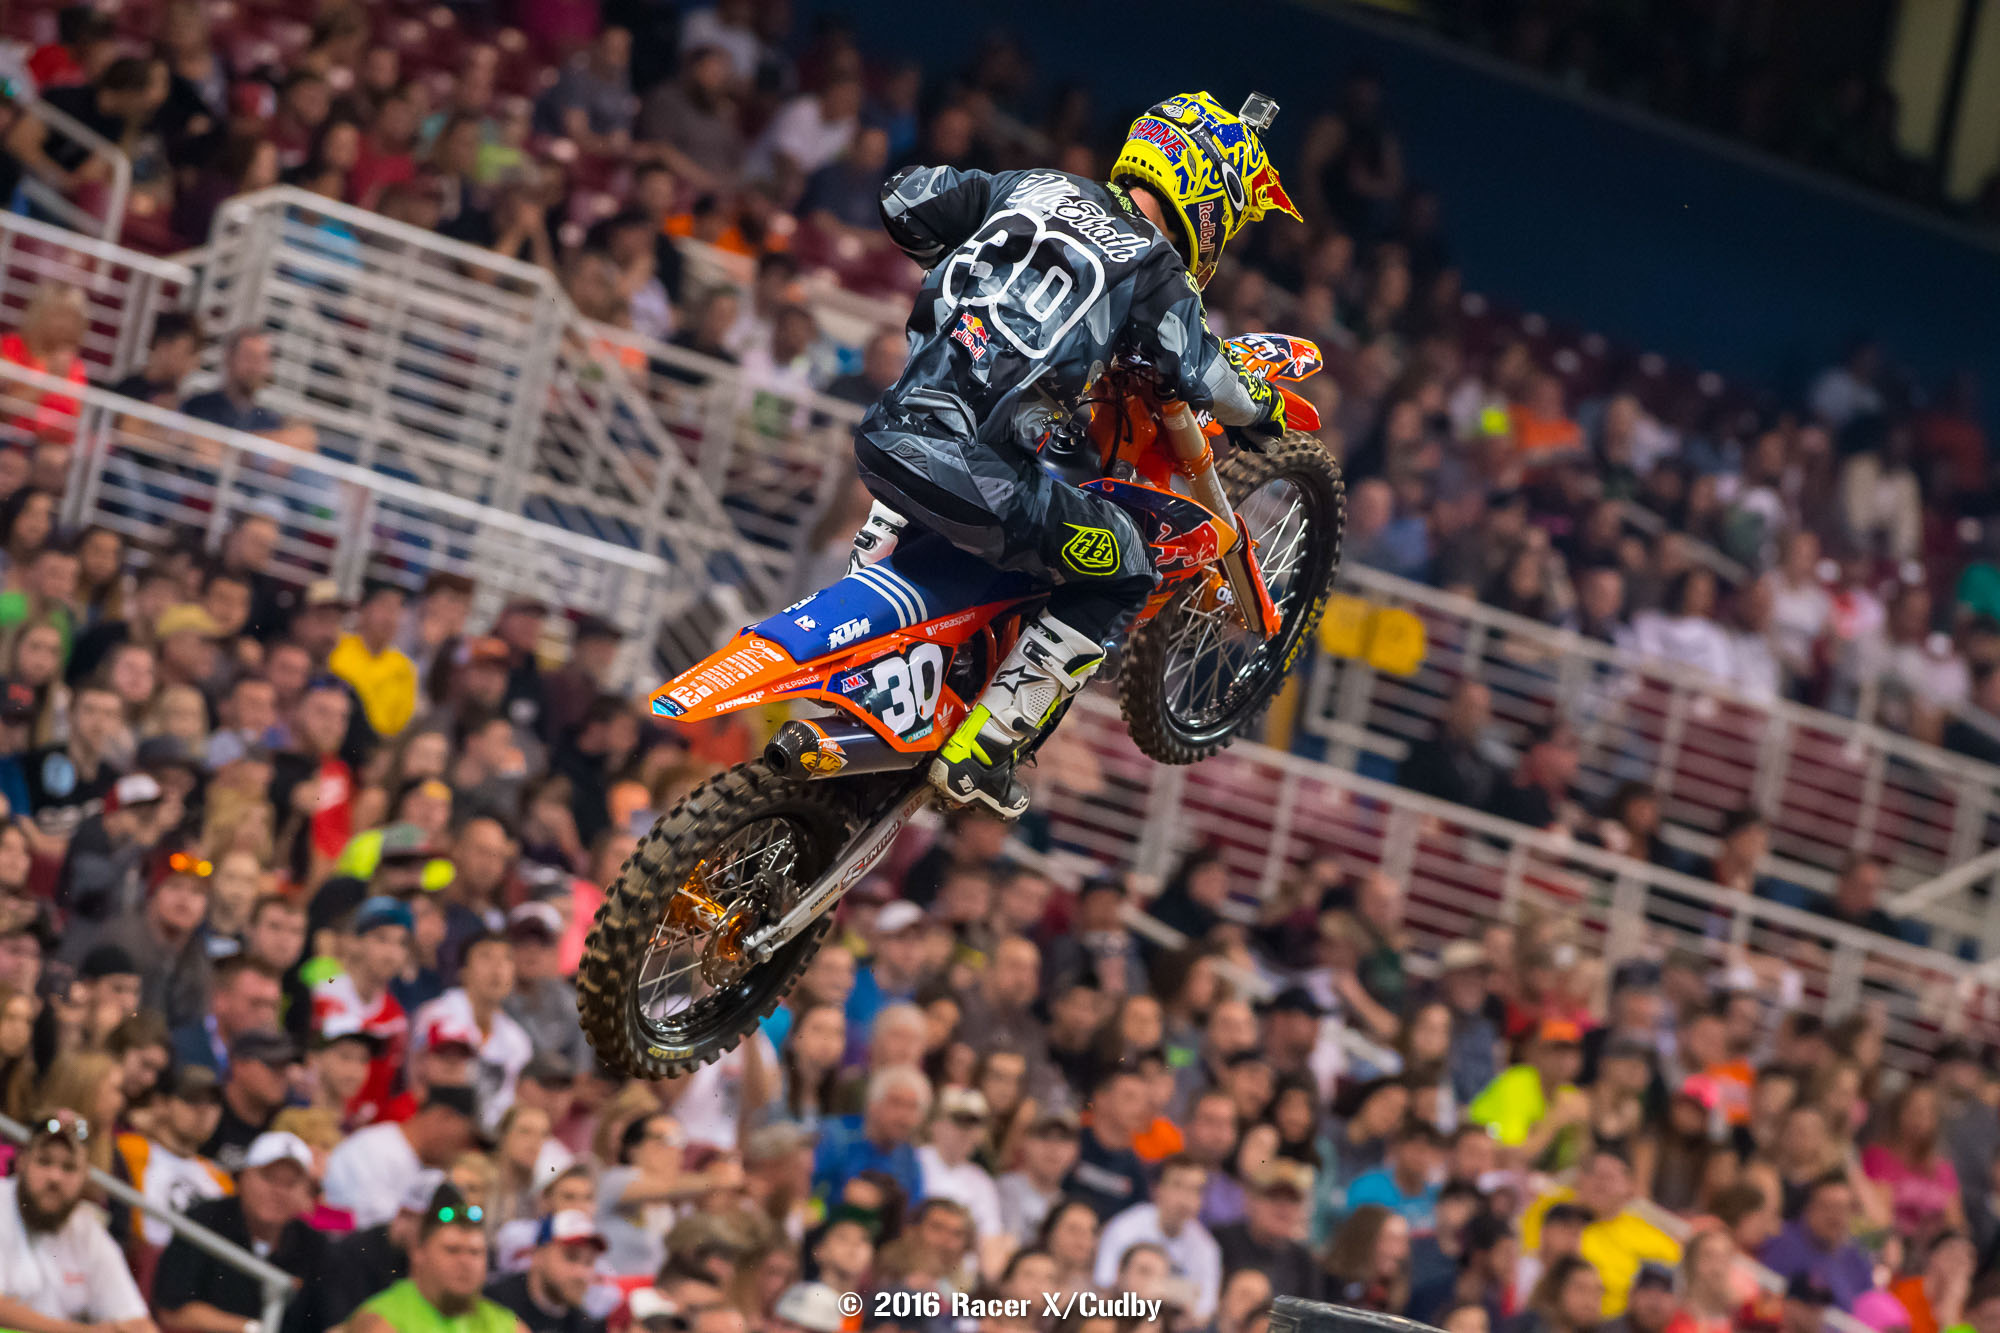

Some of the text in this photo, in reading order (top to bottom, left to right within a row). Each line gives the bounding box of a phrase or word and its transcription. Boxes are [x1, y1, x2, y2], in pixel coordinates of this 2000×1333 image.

[827, 618, 871, 651] KTM
[771, 674, 820, 693] LIFEPROOF
[841, 673, 867, 692] AMA
[872, 642, 944, 736] 30
